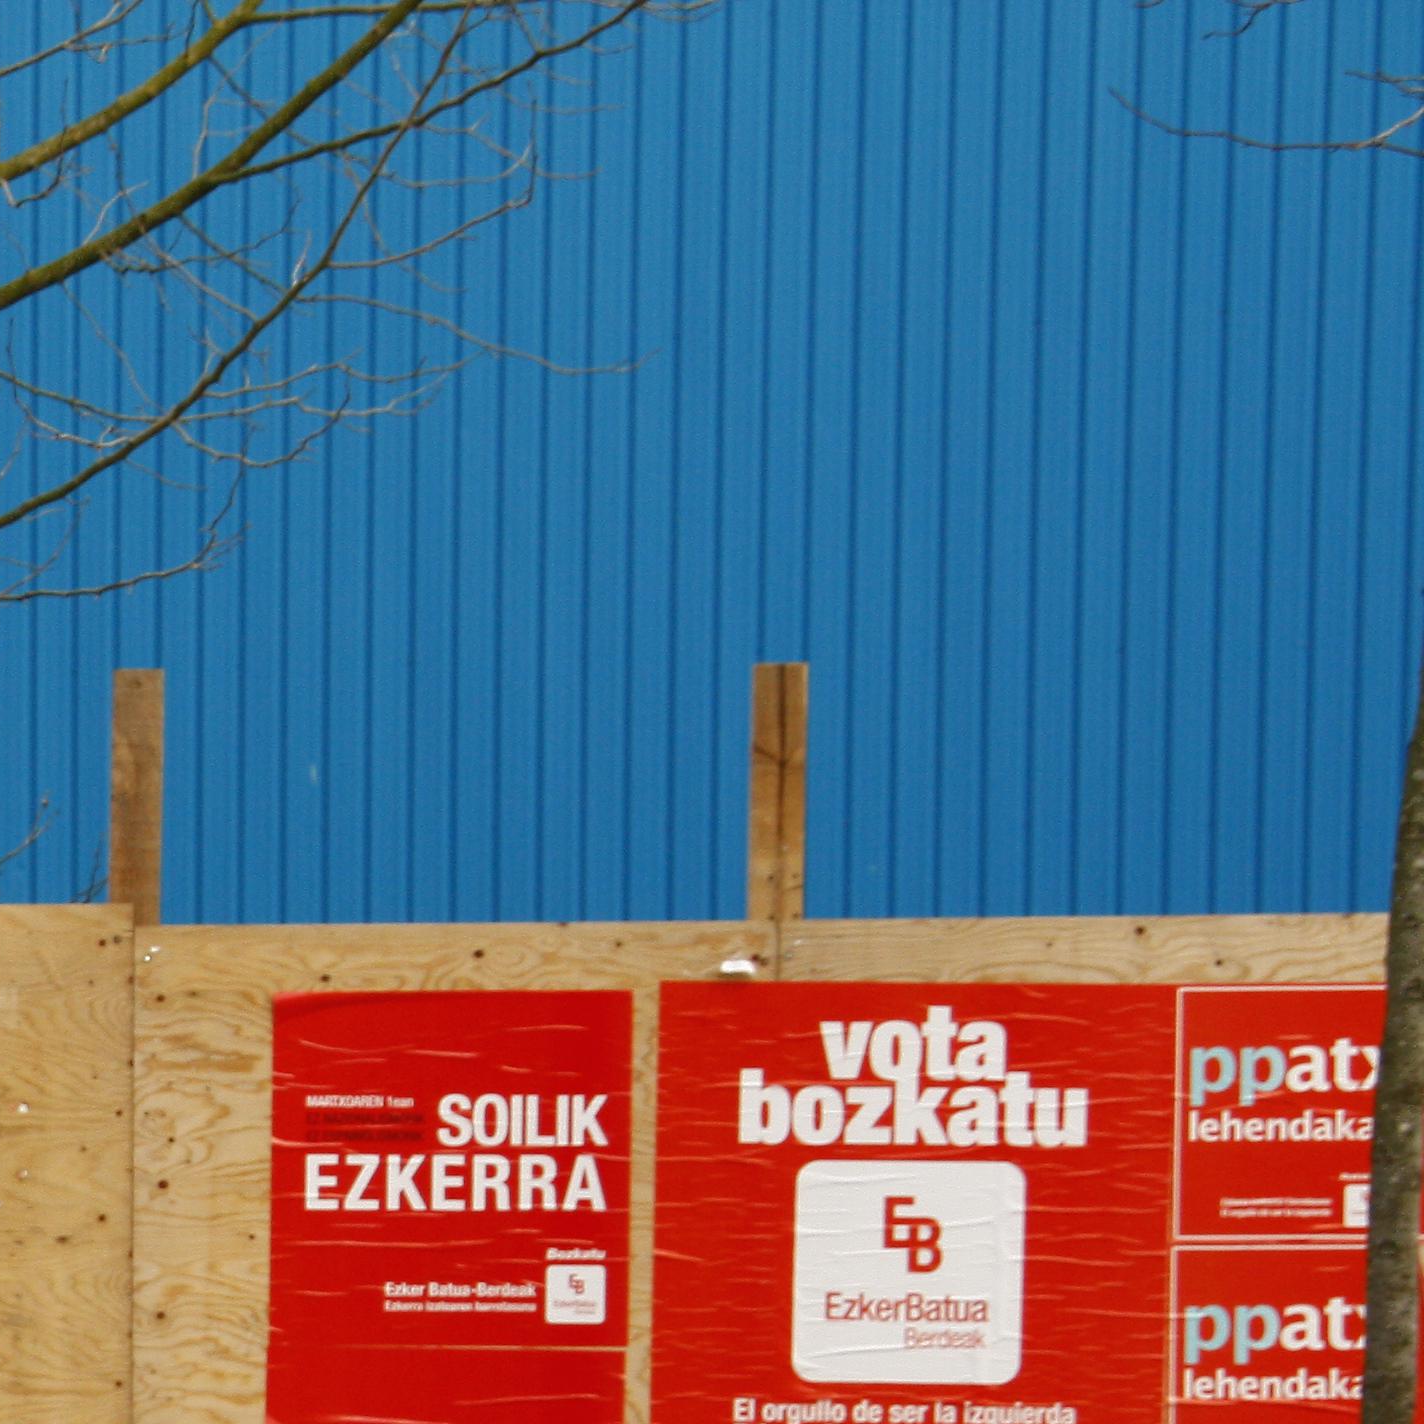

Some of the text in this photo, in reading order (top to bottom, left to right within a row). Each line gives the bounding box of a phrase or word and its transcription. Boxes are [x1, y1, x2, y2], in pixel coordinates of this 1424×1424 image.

[818, 1005, 1009, 1082] vota
[1188, 1037, 1382, 1108] ppatx
[436, 1093, 609, 1148] SOILIK
[736, 1067, 1090, 1148] bozkatu
[1187, 1107, 1376, 1143] lehendaka
[303, 1153, 608, 1213] EZKERRA
[882, 1195, 944, 1274] EB
[384, 1281, 425, 1298] Ezker
[824, 1291, 990, 1324] EzkerBatua
[904, 1326, 986, 1349] Berdeak
[1183, 1295, 1368, 1366] ppat
[732, 1397, 756, 1422] El
[852, 1400, 883, 1424] de
[888, 1404, 929, 1424] ser
[934, 1402, 957, 1424] la
[1182, 1366, 1364, 1401] lehendaka
